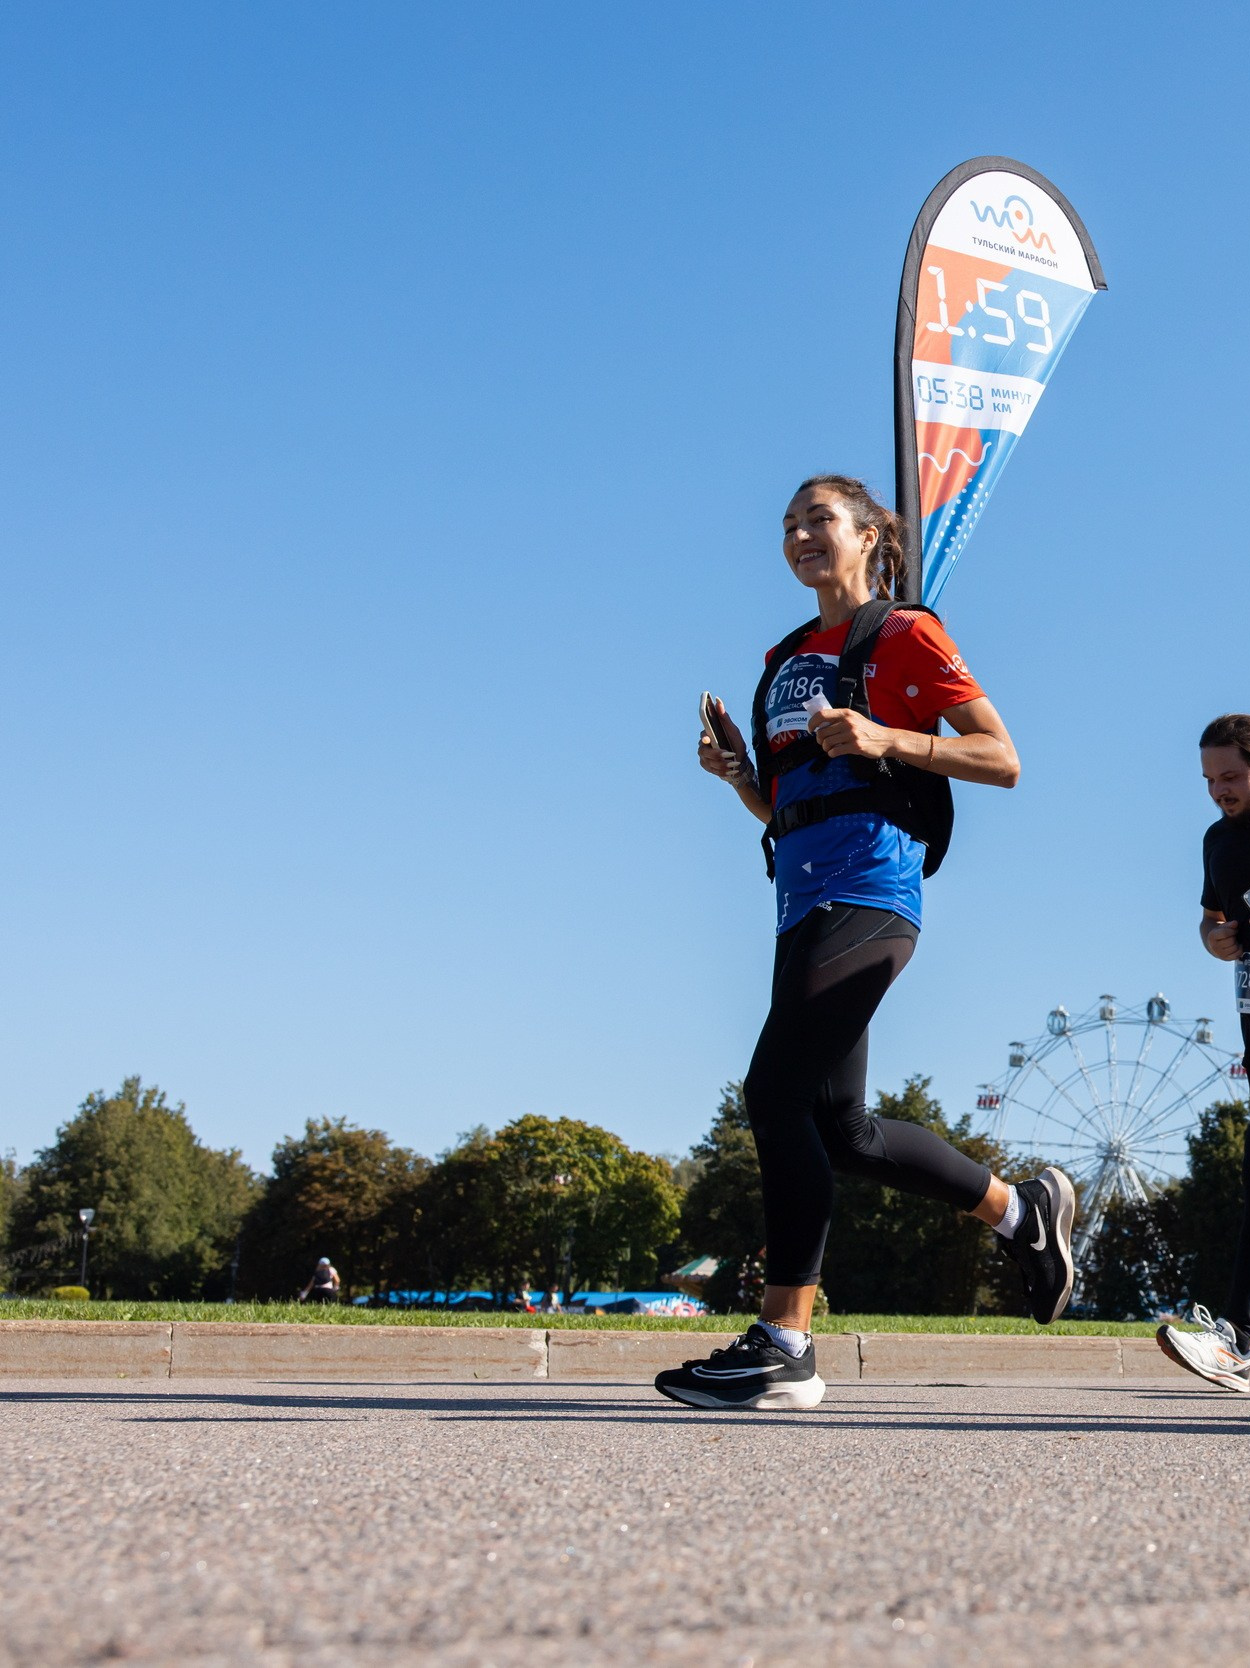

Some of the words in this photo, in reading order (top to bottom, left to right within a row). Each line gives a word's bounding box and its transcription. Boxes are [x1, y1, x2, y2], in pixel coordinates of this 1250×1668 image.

[972, 236, 1016, 256] ТУЛЬСКИЙ
[1018, 250, 1058, 269] МАРАФОН
[926, 265, 1053, 354] 1:59
[917, 375, 984, 411] 05:38
[991, 388, 1032, 405] МИНУТ
[993, 402, 1012, 414] КМ
[778, 676, 824, 703] 7186
